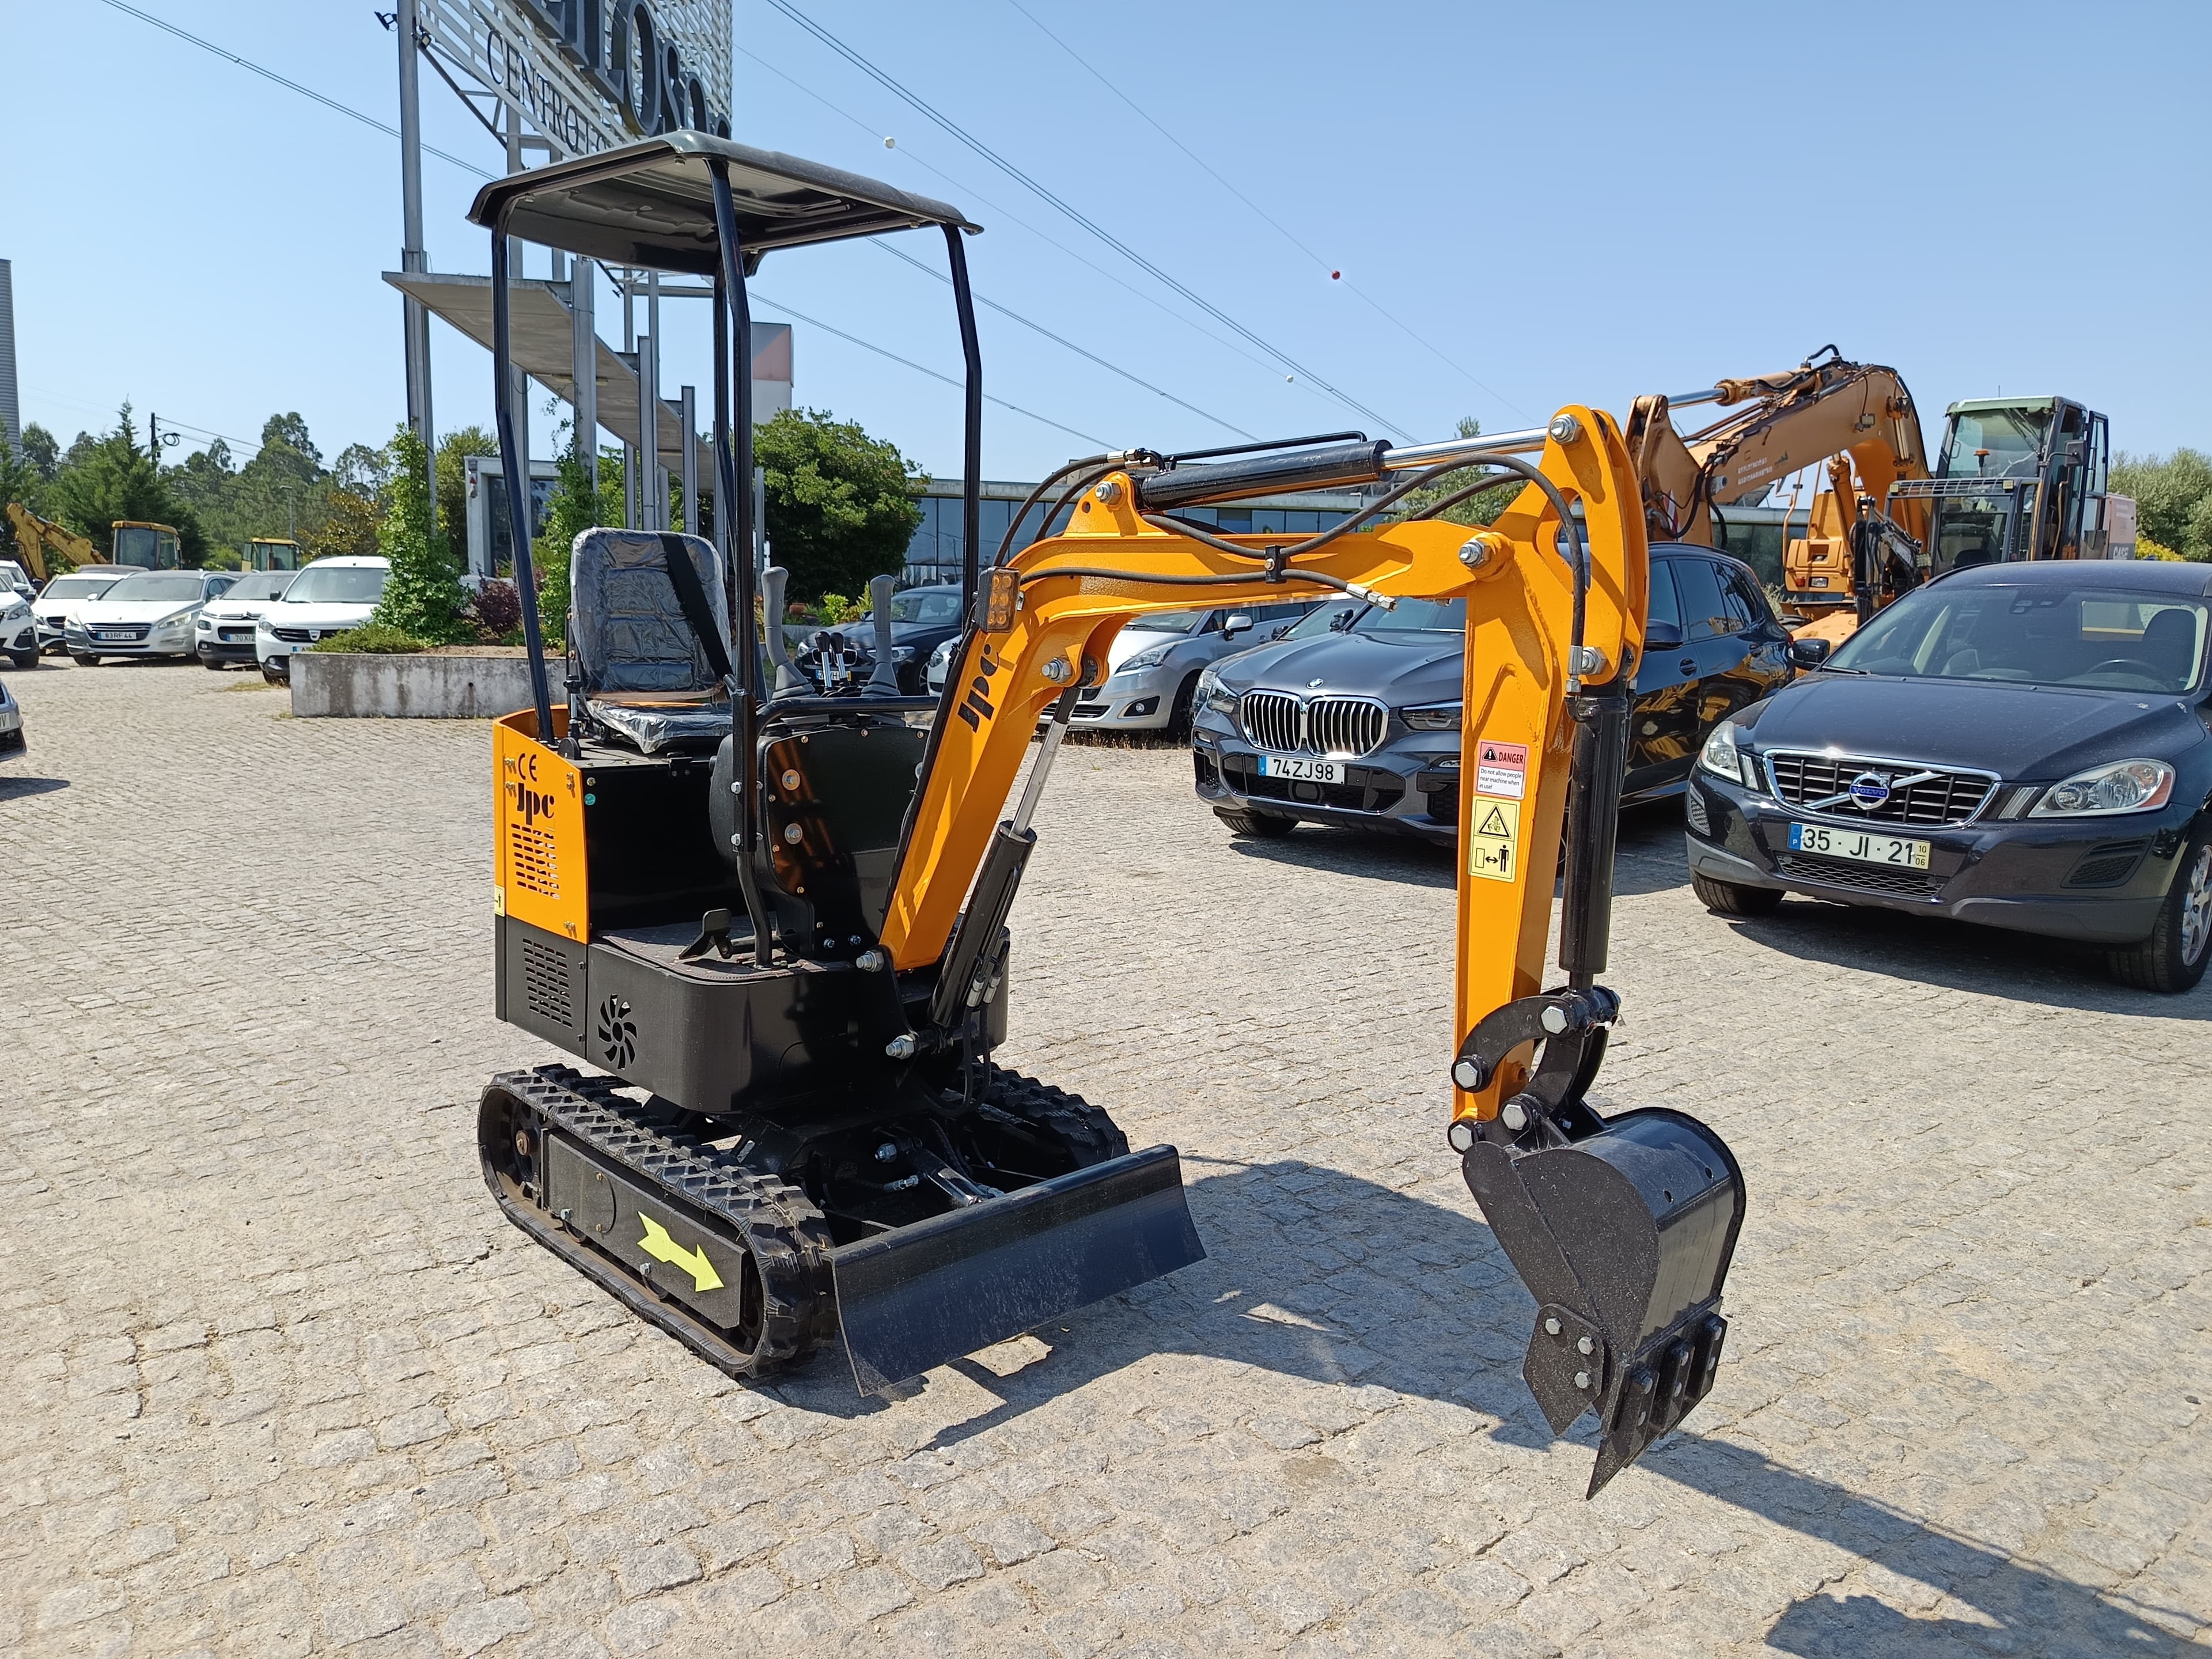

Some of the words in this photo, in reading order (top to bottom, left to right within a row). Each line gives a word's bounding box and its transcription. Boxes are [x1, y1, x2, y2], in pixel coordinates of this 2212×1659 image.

[487, 29, 579, 153] CENTRO
[1498, 752, 1524, 764] DANGER
[1853, 786, 1886, 797] VOLVO
